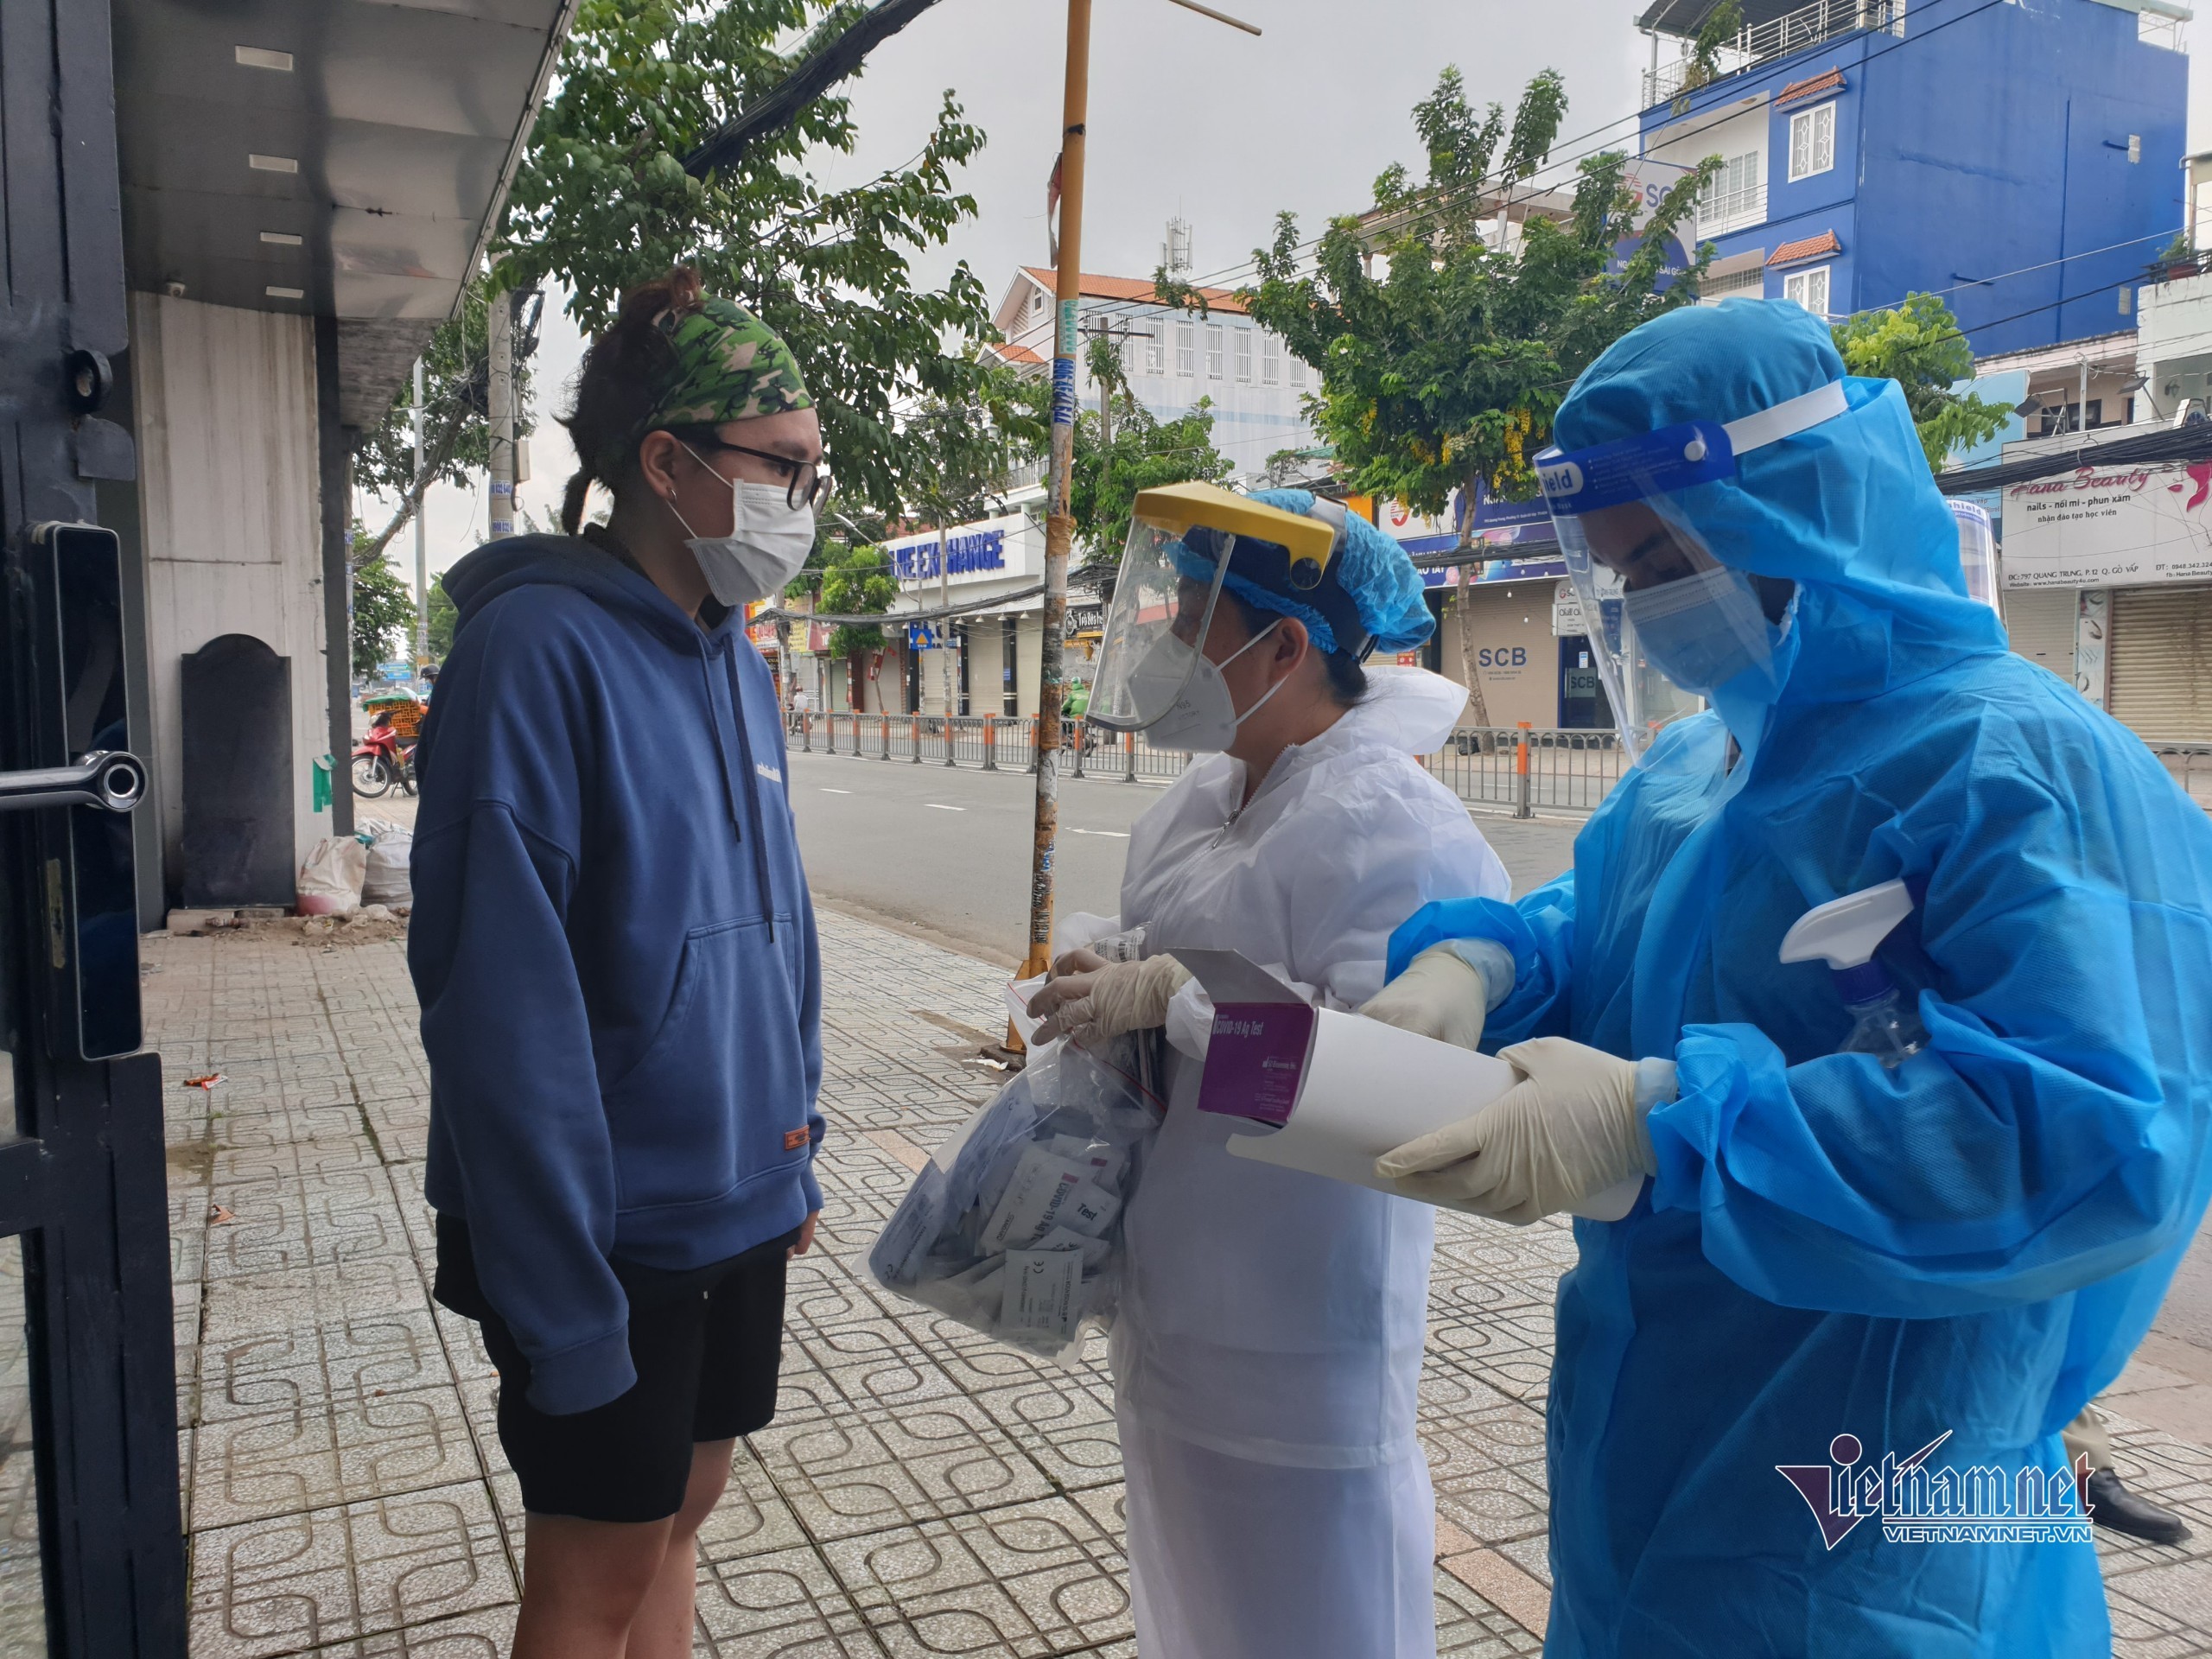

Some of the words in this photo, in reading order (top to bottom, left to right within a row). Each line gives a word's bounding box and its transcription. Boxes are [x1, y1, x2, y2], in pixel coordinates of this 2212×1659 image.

[2074, 467, 2150, 492] Beauty
[2026, 502, 2047, 512] nails
[2069, 499, 2080, 507] mi
[2088, 496, 2109, 508] phun
[2085, 511, 2099, 519] học
[916, 529, 1005, 581] EXHANGE
[2033, 571, 2057, 580] QUANG
[1478, 646, 1527, 668] SCB
[1570, 676, 1595, 689] SCB
[1250, 1020, 1264, 1035] Test
[1044, 1181, 1070, 1221] COVID-19
[1077, 1202, 1098, 1222] Test
